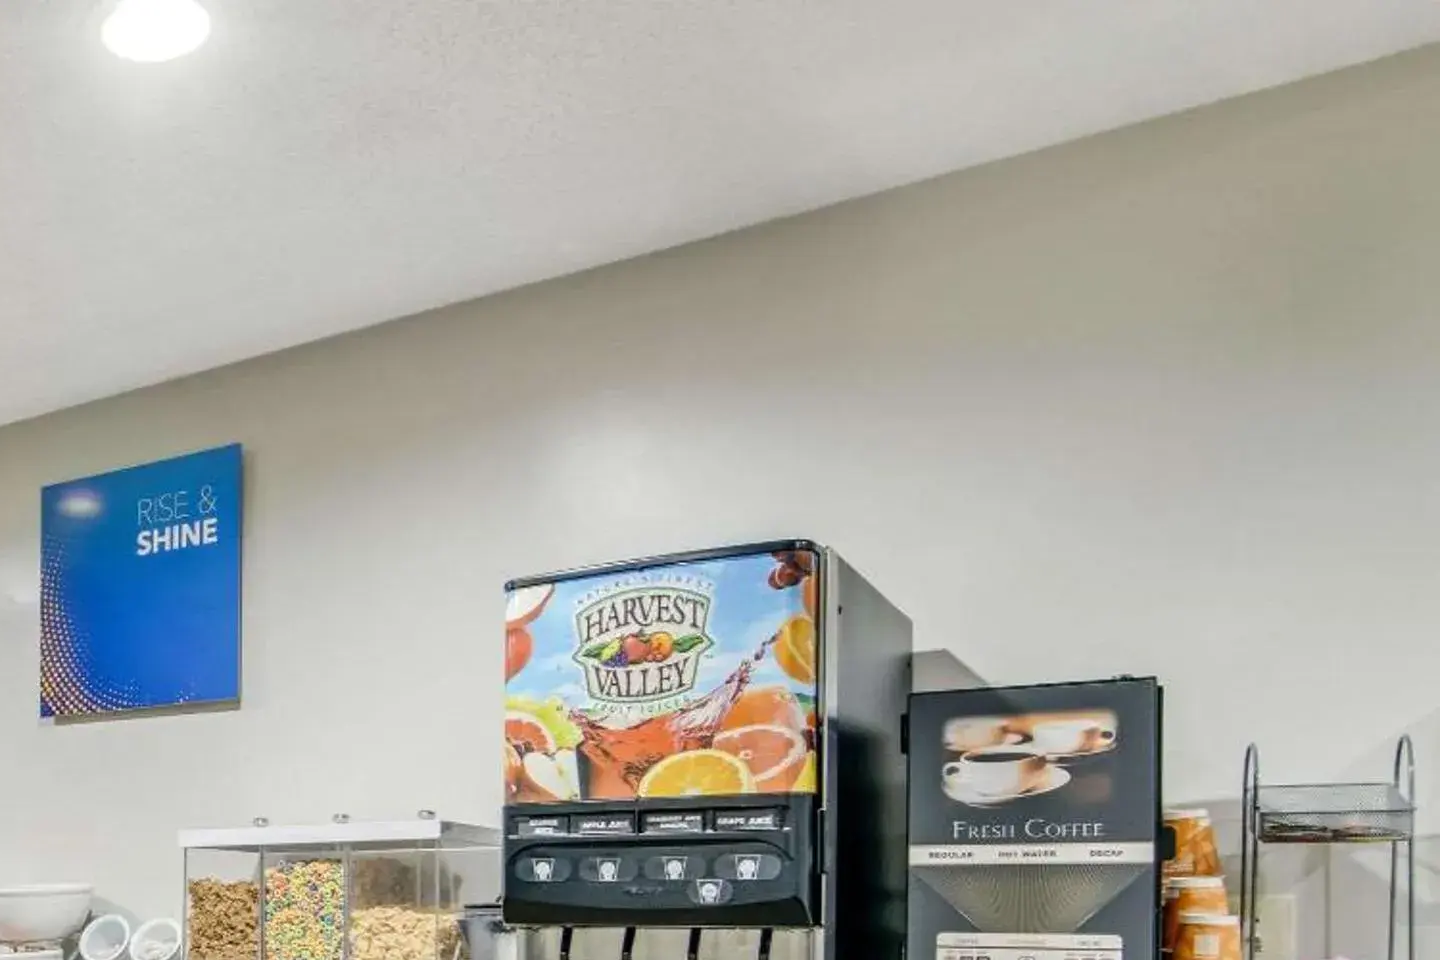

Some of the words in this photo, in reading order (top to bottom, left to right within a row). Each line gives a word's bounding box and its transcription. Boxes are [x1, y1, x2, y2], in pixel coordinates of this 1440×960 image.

[138, 490, 190, 526] RISE
[199, 484, 217, 514] &
[136, 517, 219, 556] SHINE
[584, 593, 707, 644] HARVEST
[591, 656, 692, 698] VALLEY
[952, 820, 1016, 840] FRESH
[1024, 818, 1105, 838] COFFEE
[928, 851, 974, 860] REGULAR
